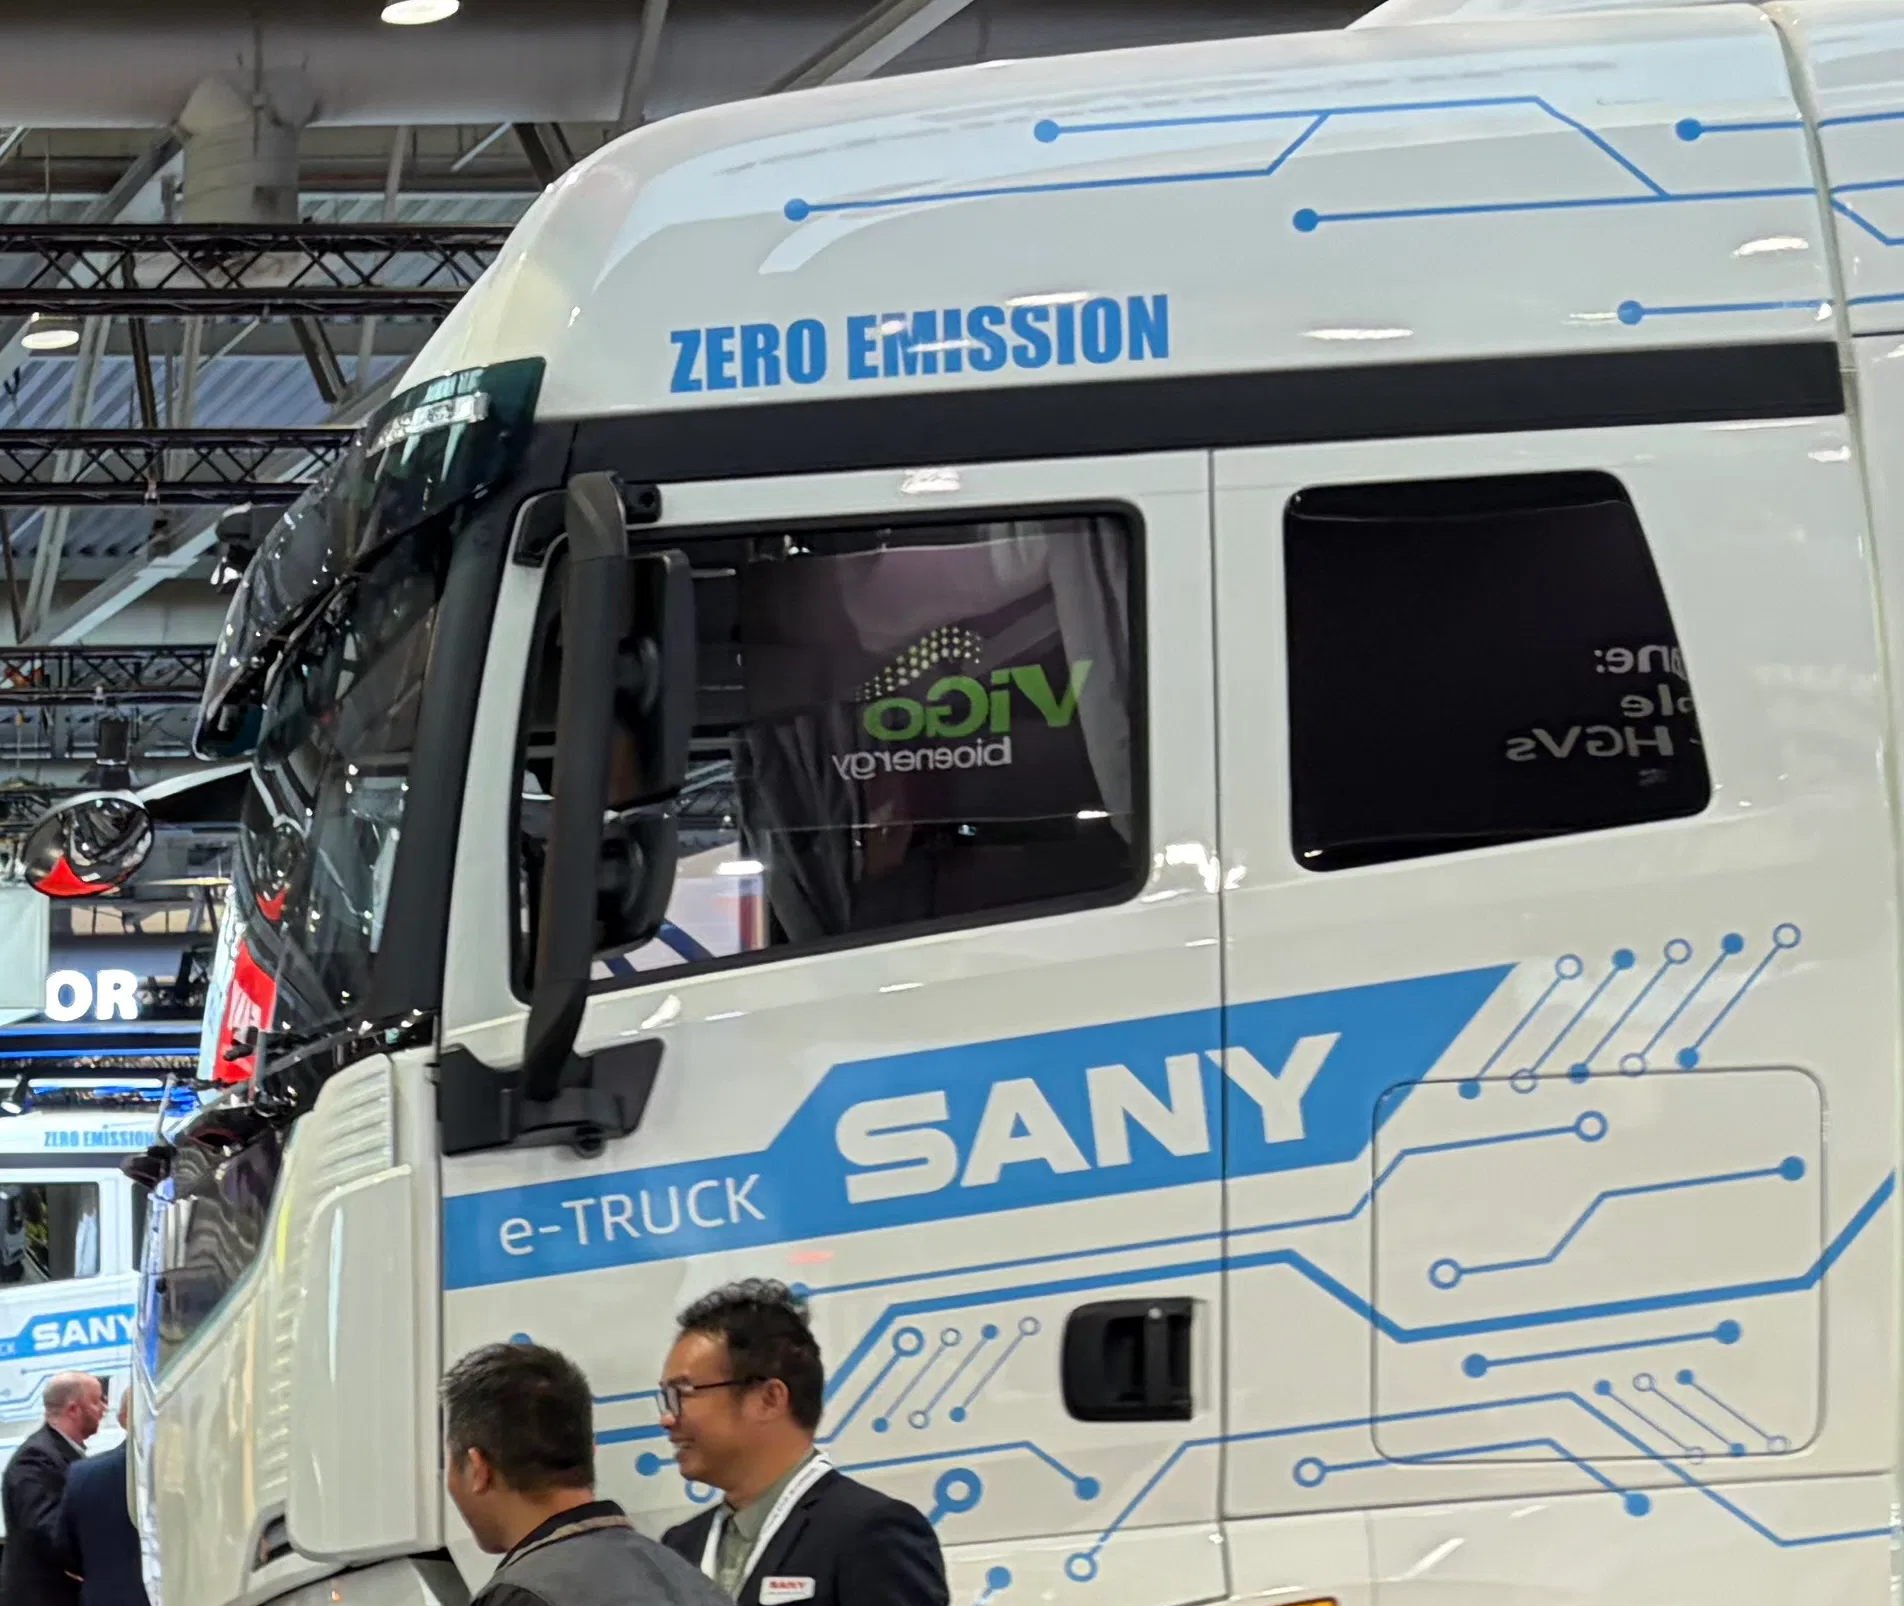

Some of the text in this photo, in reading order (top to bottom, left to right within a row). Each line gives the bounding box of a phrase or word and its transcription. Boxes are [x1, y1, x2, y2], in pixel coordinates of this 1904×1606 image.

[670, 293, 1170, 394] ZERO EMISSION
[44, 1130, 80, 1148] ZERO
[498, 1032, 1342, 1257] e-TRUCK SANY
[31, 1313, 138, 1352] SANY
